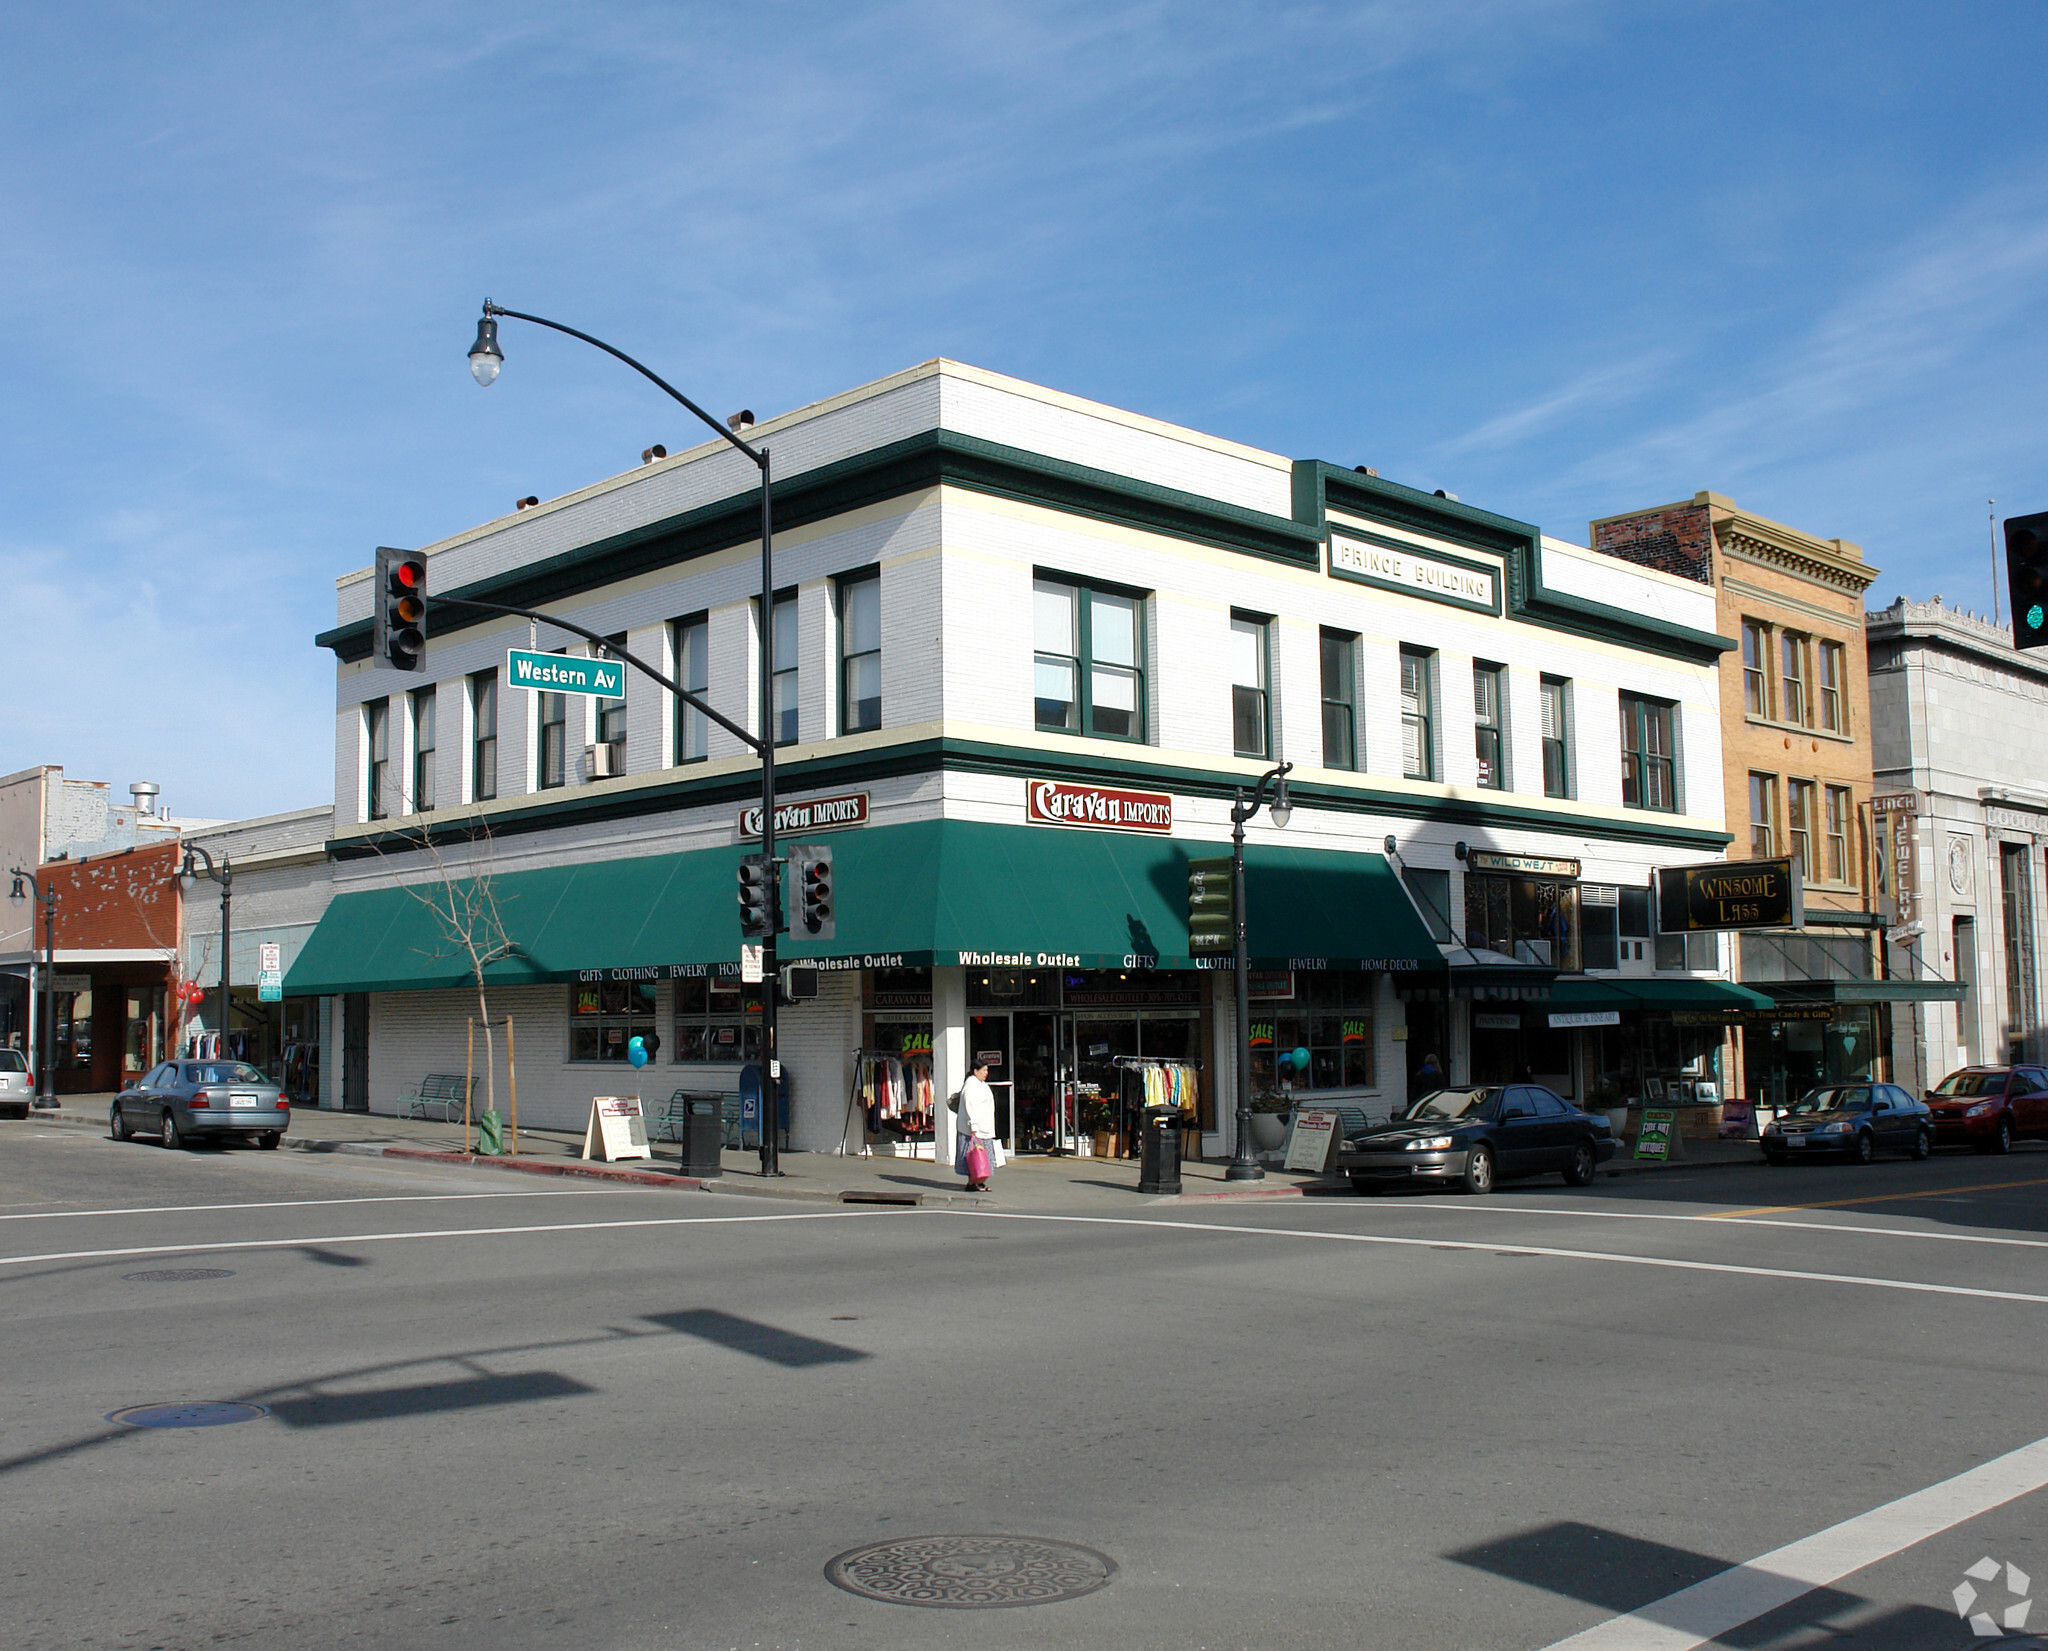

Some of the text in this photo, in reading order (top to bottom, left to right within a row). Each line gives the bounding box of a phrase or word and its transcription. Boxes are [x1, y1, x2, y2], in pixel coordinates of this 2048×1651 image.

[1341, 544, 1484, 597] PRINCE BUILDING
[517, 659, 616, 689] Western Av
[1035, 782, 1170, 825] Caravan IMPORTS
[744, 798, 859, 836] Caavan IMPORTS
[1490, 855, 1520, 868] WILD
[1523, 859, 1553, 871] WEST
[1895, 815, 1911, 920] JEWELRY
[1700, 874, 1777, 899] WINSOME
[864, 954, 903, 967] Outlet
[958, 951, 1080, 967] Wholesale Outlet
[1123, 954, 1155, 968] GIFTS
[1195, 956, 1252, 970] CLOTHIG
[1288, 957, 1328, 971] JEWELRY
[1361, 958, 1418, 971] HOME DECOR
[579, 968, 603, 982] GIFTS
[611, 966, 659, 981] CLOTHING
[669, 963, 708, 979] JEWELRY
[718, 962, 742, 976] HOM
[578, 992, 598, 1009] SALE
[875, 994, 917, 1005] CARAVAN
[1070, 991, 1114, 1003] WHOLESALE
[1116, 991, 1144, 1002] OUTLET
[1178, 991, 1193, 1001] OFF
[1552, 1012, 1616, 1025] ANTIQUES & FINE ART
[1778, 1010, 1801, 1020] Candy
[1812, 1010, 1831, 1019] Gifts
[1249, 1023, 1274, 1041] SALE
[1343, 1020, 1365, 1036] SALE
[902, 1033, 933, 1053] SAL
